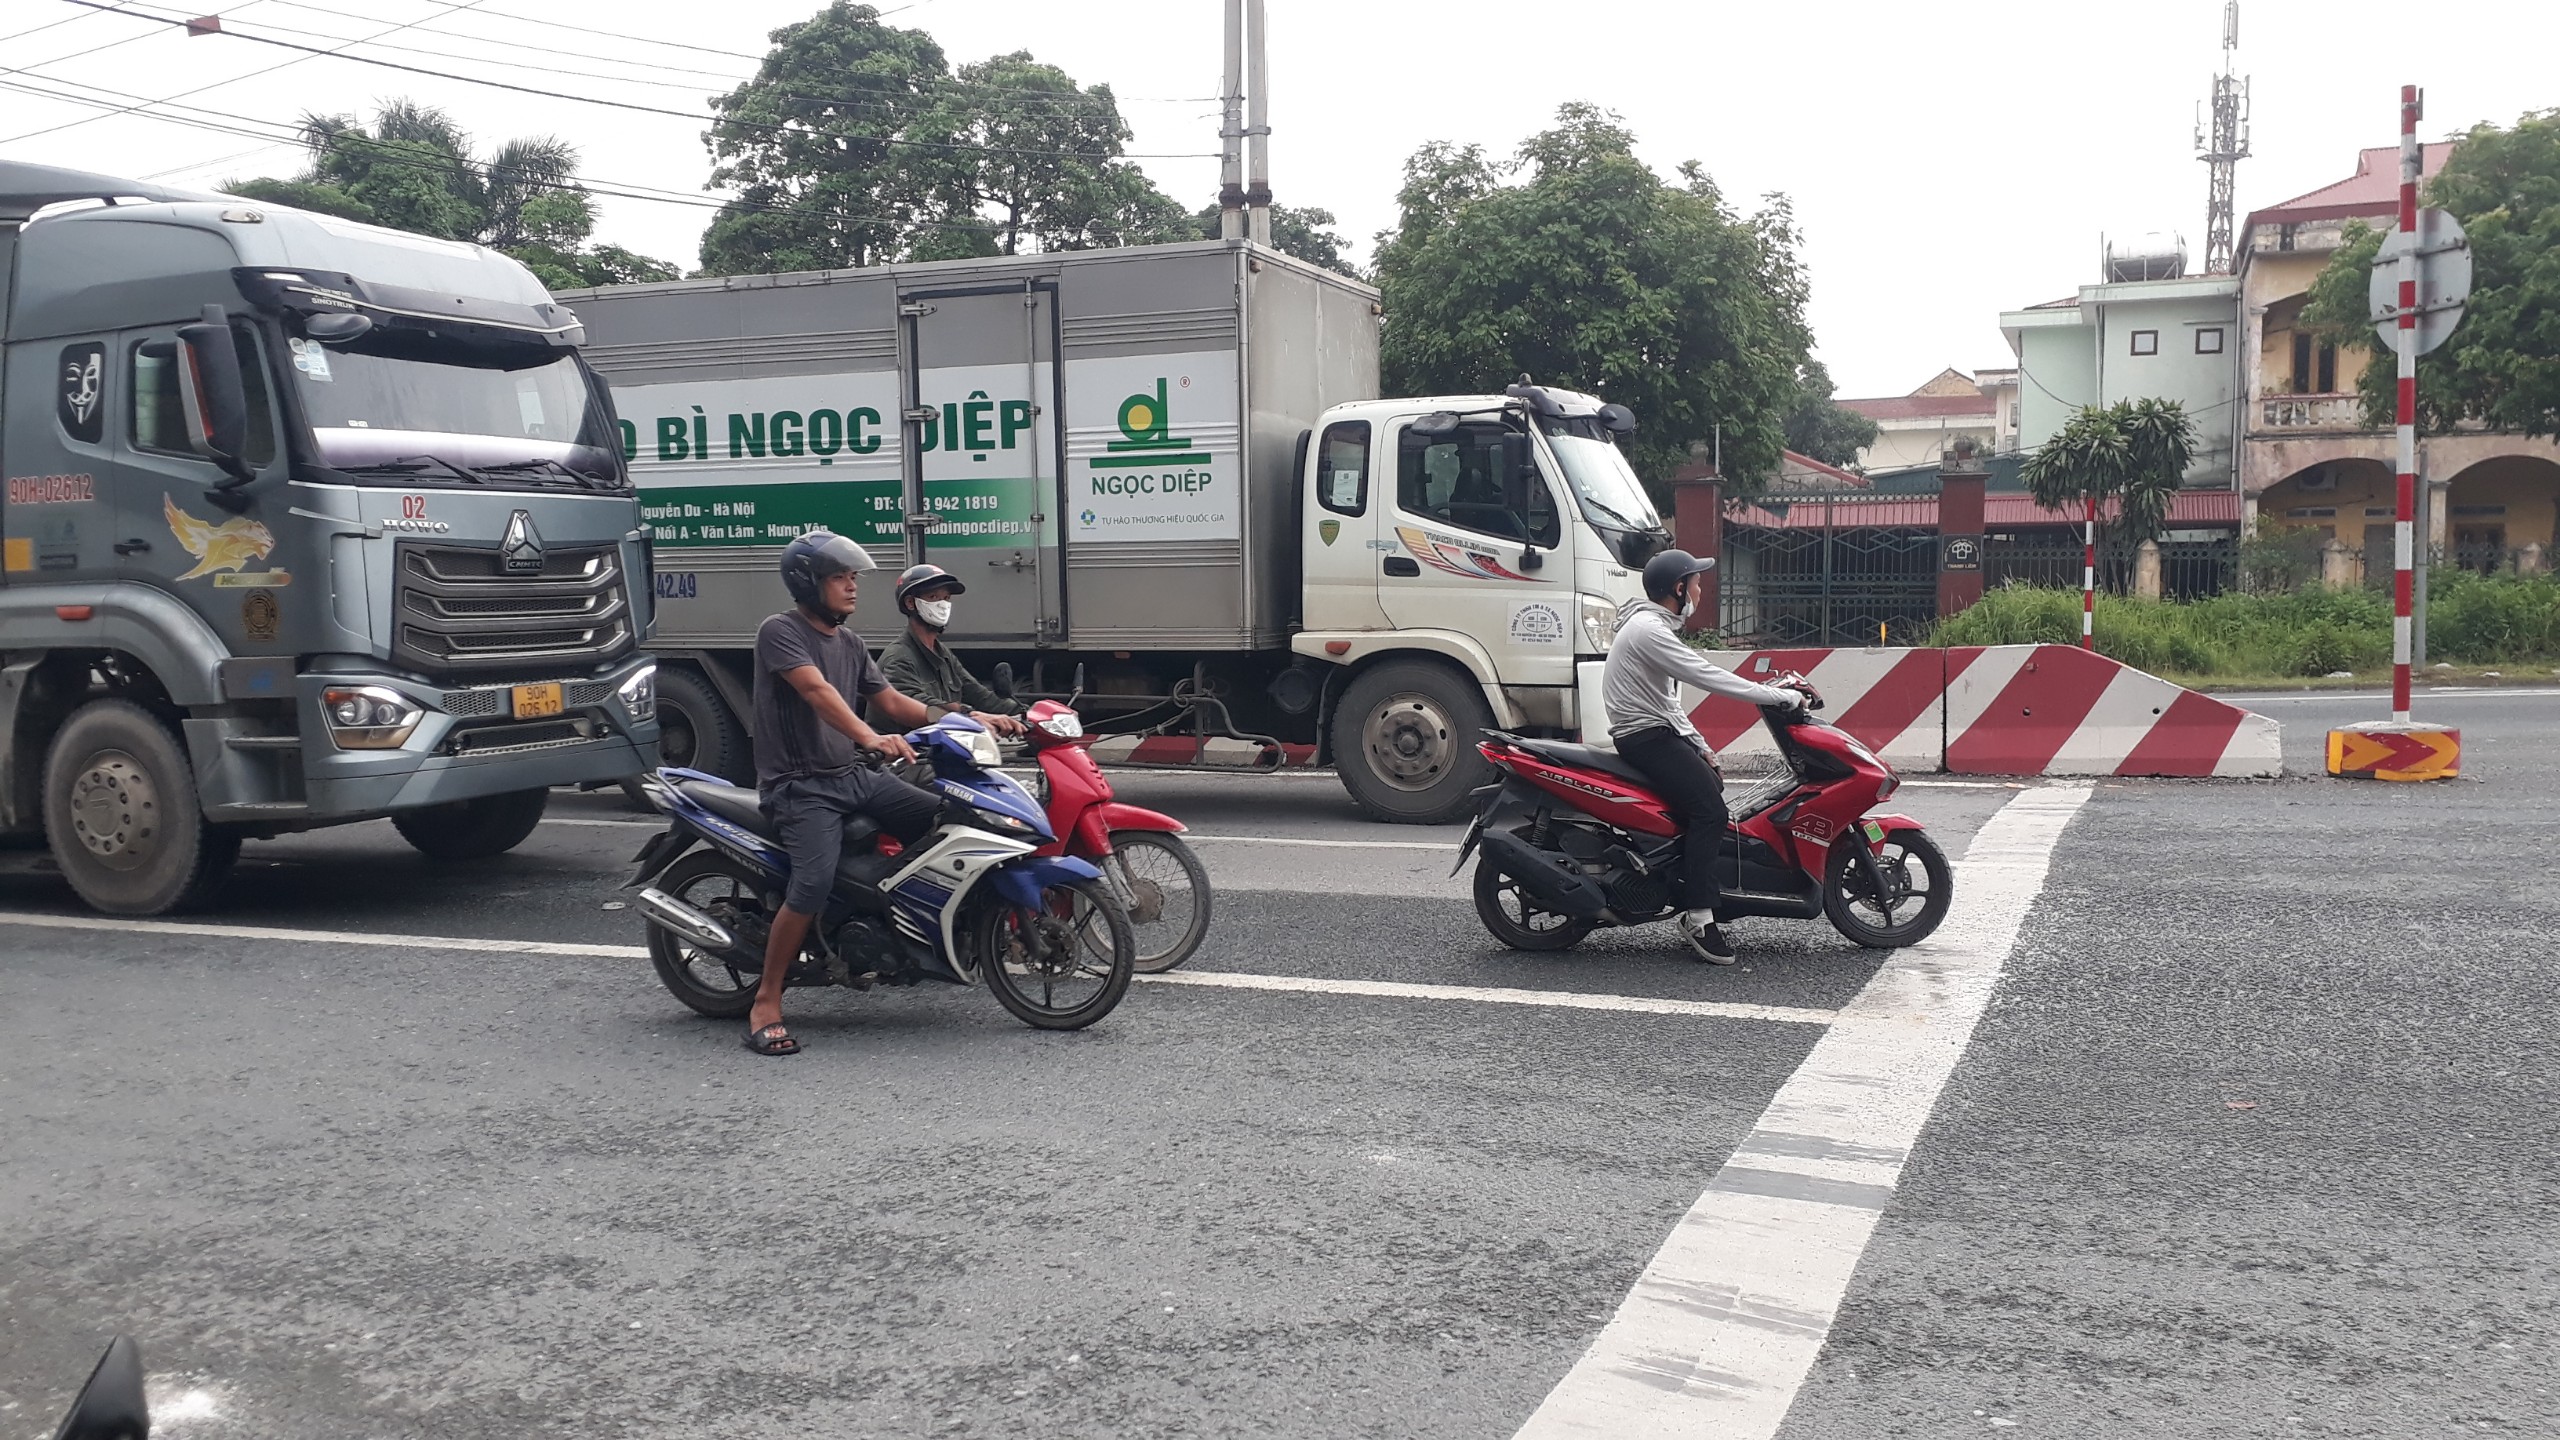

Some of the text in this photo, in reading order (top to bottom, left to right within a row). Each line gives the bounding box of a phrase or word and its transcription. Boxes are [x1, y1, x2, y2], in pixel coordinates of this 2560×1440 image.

[657, 405, 708, 462] BÌ
[728, 406, 882, 466] NGỌC
[1091, 468, 1212, 499] NGỌC DIỆP
[402, 495, 426, 519] 02
[684, 504, 701, 517] Du
[713, 502, 730, 517] Hà
[733, 501, 755, 519] Nội
[934, 496, 960, 510] 942
[964, 495, 998, 509] 1819
[381, 518, 449, 533] HOWO
[1101, 512, 1225, 526] TỰ HÀO THƯƠNG HIỆU QUỐC GIA
[655, 524, 676, 540] Nối
[680, 527, 689, 540] A
[700, 524, 725, 539] Văn
[728, 523, 755, 538] Lâm
[767, 523, 800, 539] Hưng
[527, 686, 548, 700] 90H
[943, 784, 975, 803] YAMAHA
